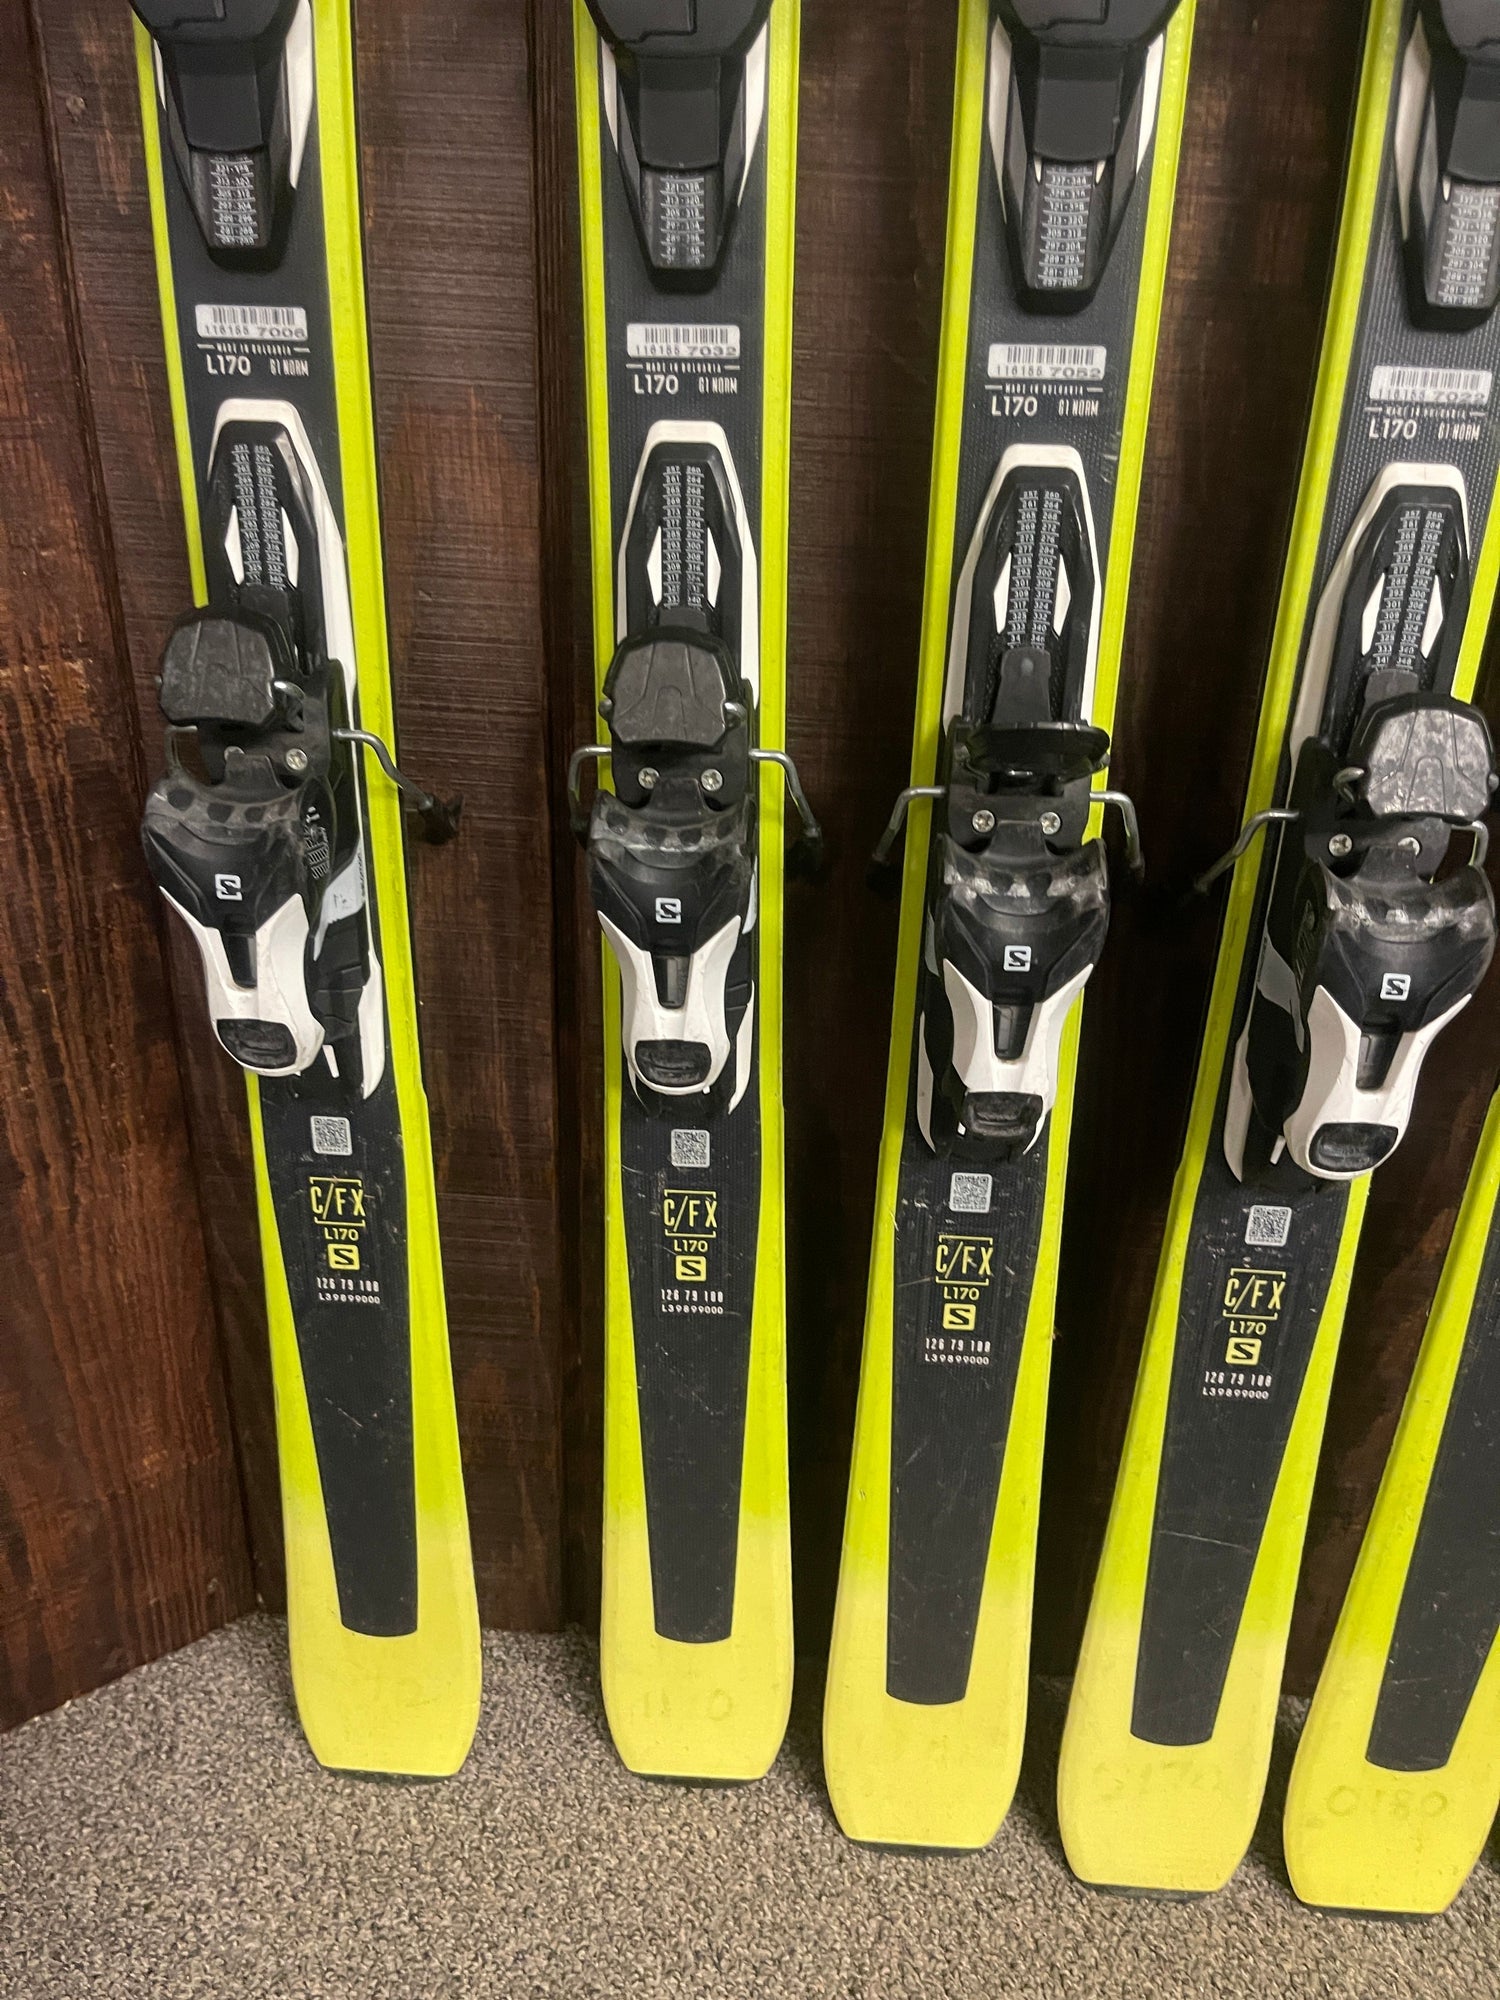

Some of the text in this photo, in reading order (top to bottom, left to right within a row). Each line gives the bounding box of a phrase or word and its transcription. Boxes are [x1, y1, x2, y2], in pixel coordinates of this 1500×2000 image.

[687, 346, 737, 356] 7032
[206, 354, 252, 376] L170
[1049, 366, 1101, 378] 7052
[634, 374, 679, 395] L170
[991, 395, 1038, 417] L170
[1369, 417, 1417, 440] L170
[1022, 501, 1037, 510] 261
[1020, 523, 1056, 532] 269 272
[1019, 534, 1055, 544] 273 276
[1018, 546, 1033, 554] 277
[1038, 557, 1053, 566] 292
[1396, 555, 1433, 564] 273 276
[1016, 568, 1052, 577] 293 300
[1393, 566, 1409, 574] 277
[1015, 579, 1030, 587] 301
[1014, 590, 1050, 599] 309 316
[1411, 589, 1426, 598] 300
[1013, 601, 1028, 609] 317
[1387, 600, 1402, 608] 301
[1033, 612, 1048, 621] 332
[1385, 611, 1421, 621] 309 316
[1011, 623, 1026, 631] 333
[1382, 622, 1397, 630] 317
[1010, 634, 1021, 642] 34
[324, 1227, 359, 1241] L170
[673, 1239, 709, 1252] L170
[316, 1277, 335, 1290] 126
[340, 1278, 354, 1291] 79
[319, 1292, 381, 1304] L39899000
[661, 1288, 679, 1301] 126
[685, 1289, 698, 1302] 79
[943, 1286, 980, 1301] L170
[661, 1304, 724, 1315] L39899000
[1229, 1320, 1267, 1335] L170
[925, 1337, 944, 1351] 126
[950, 1339, 964, 1351] 79
[924, 1353, 990, 1365] L39899000
[1204, 1370, 1225, 1384] 126
[1230, 1372, 1245, 1385] 79
[1202, 1387, 1269, 1400] L39899000
